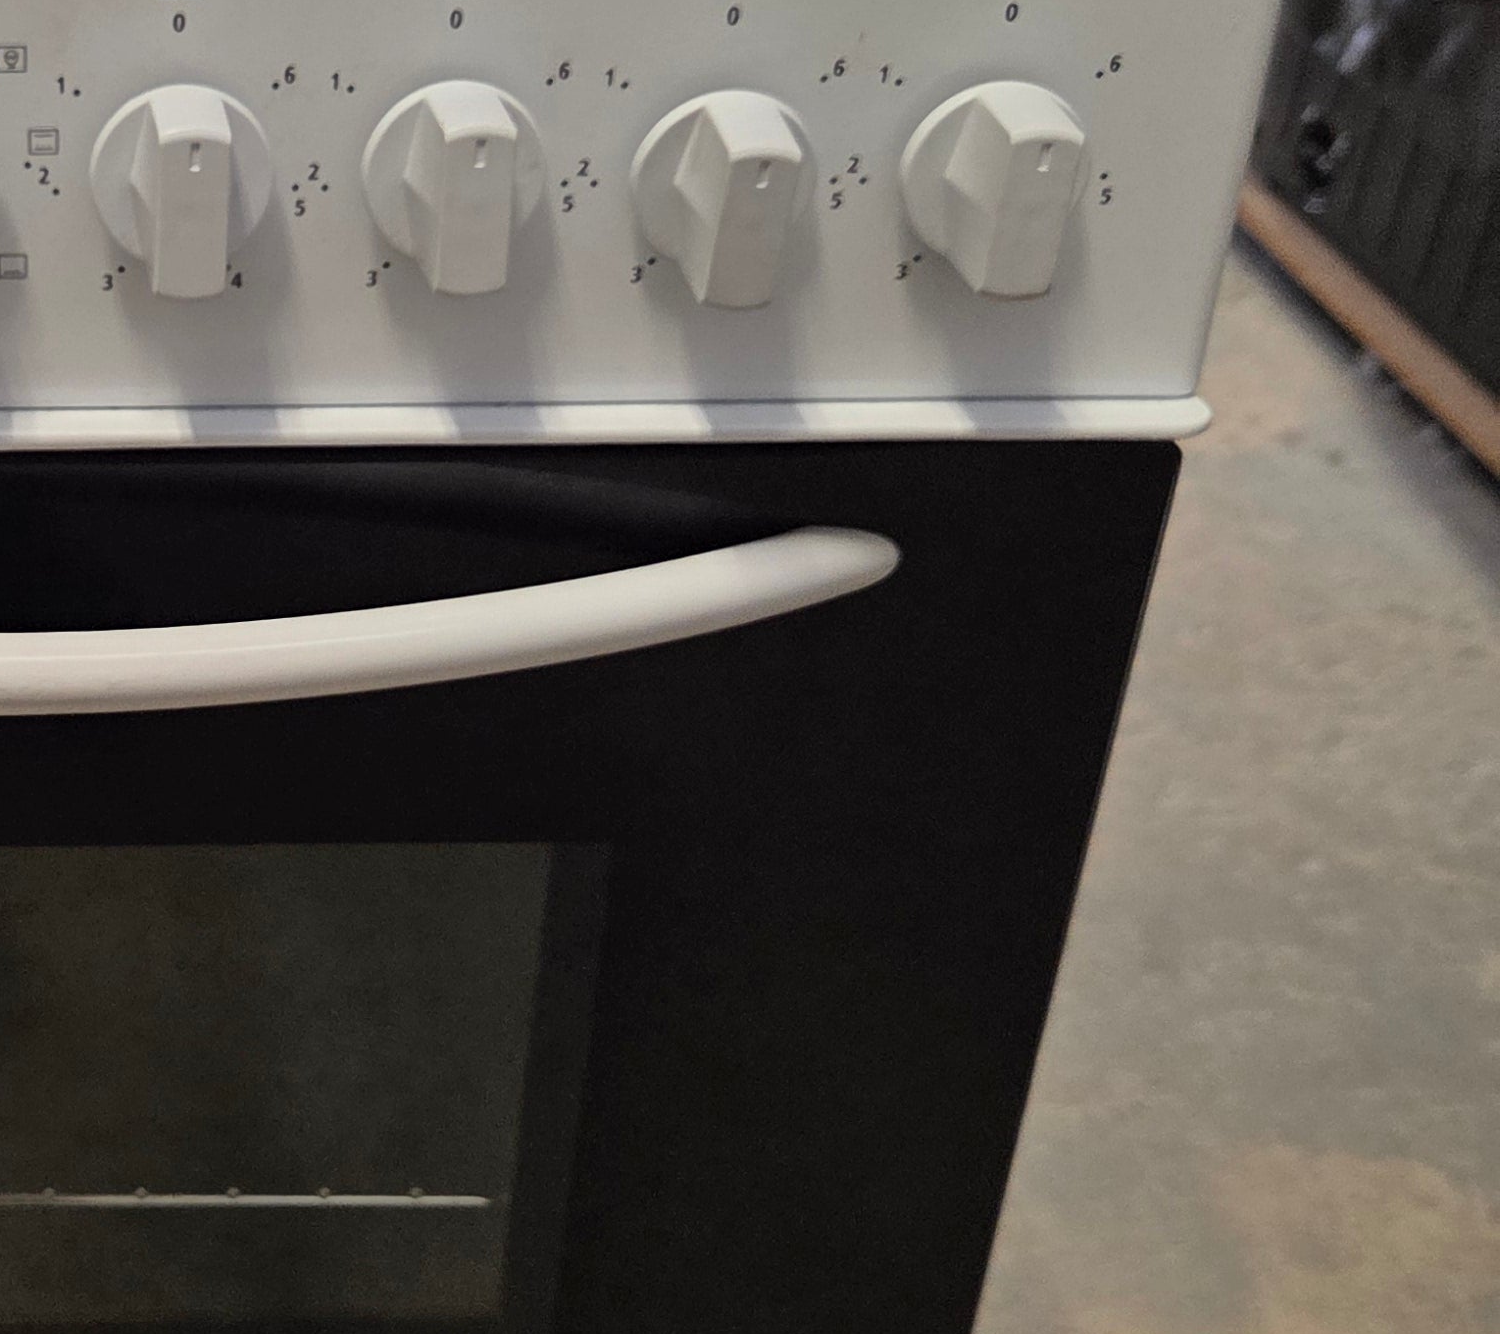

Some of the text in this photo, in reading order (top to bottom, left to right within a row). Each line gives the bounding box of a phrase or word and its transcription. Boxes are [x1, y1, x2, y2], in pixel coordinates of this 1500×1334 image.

[449, 9, 463, 30] 0
[726, 6, 741, 26] 0
[1005, 2, 1019, 23] 0
[172, 13, 186, 33] 0
[558, 61, 571, 81] 6
[833, 58, 846, 77] 6
[1109, 54, 1122, 73] 6
[284, 65, 296, 85] 6
[331, 72, 340, 91] 1
[605, 68, 614, 87] 1
[880, 65, 889, 84] 1
[57, 76, 65, 94] 1
[307, 163, 320, 181] 2
[576, 159, 590, 177] 2
[846, 156, 860, 174] 2
[38, 166, 50, 185] 2
[562, 194, 574, 213] 5
[830, 191, 843, 210] 5
[1099, 187, 1112, 206] 5
[294, 199, 306, 217] 5
[230, 272, 243, 289] 4
[366, 269, 379, 287] 3
[630, 266, 643, 284] 3
[895, 262, 909, 281] 3
[102, 274, 114, 292] 3
